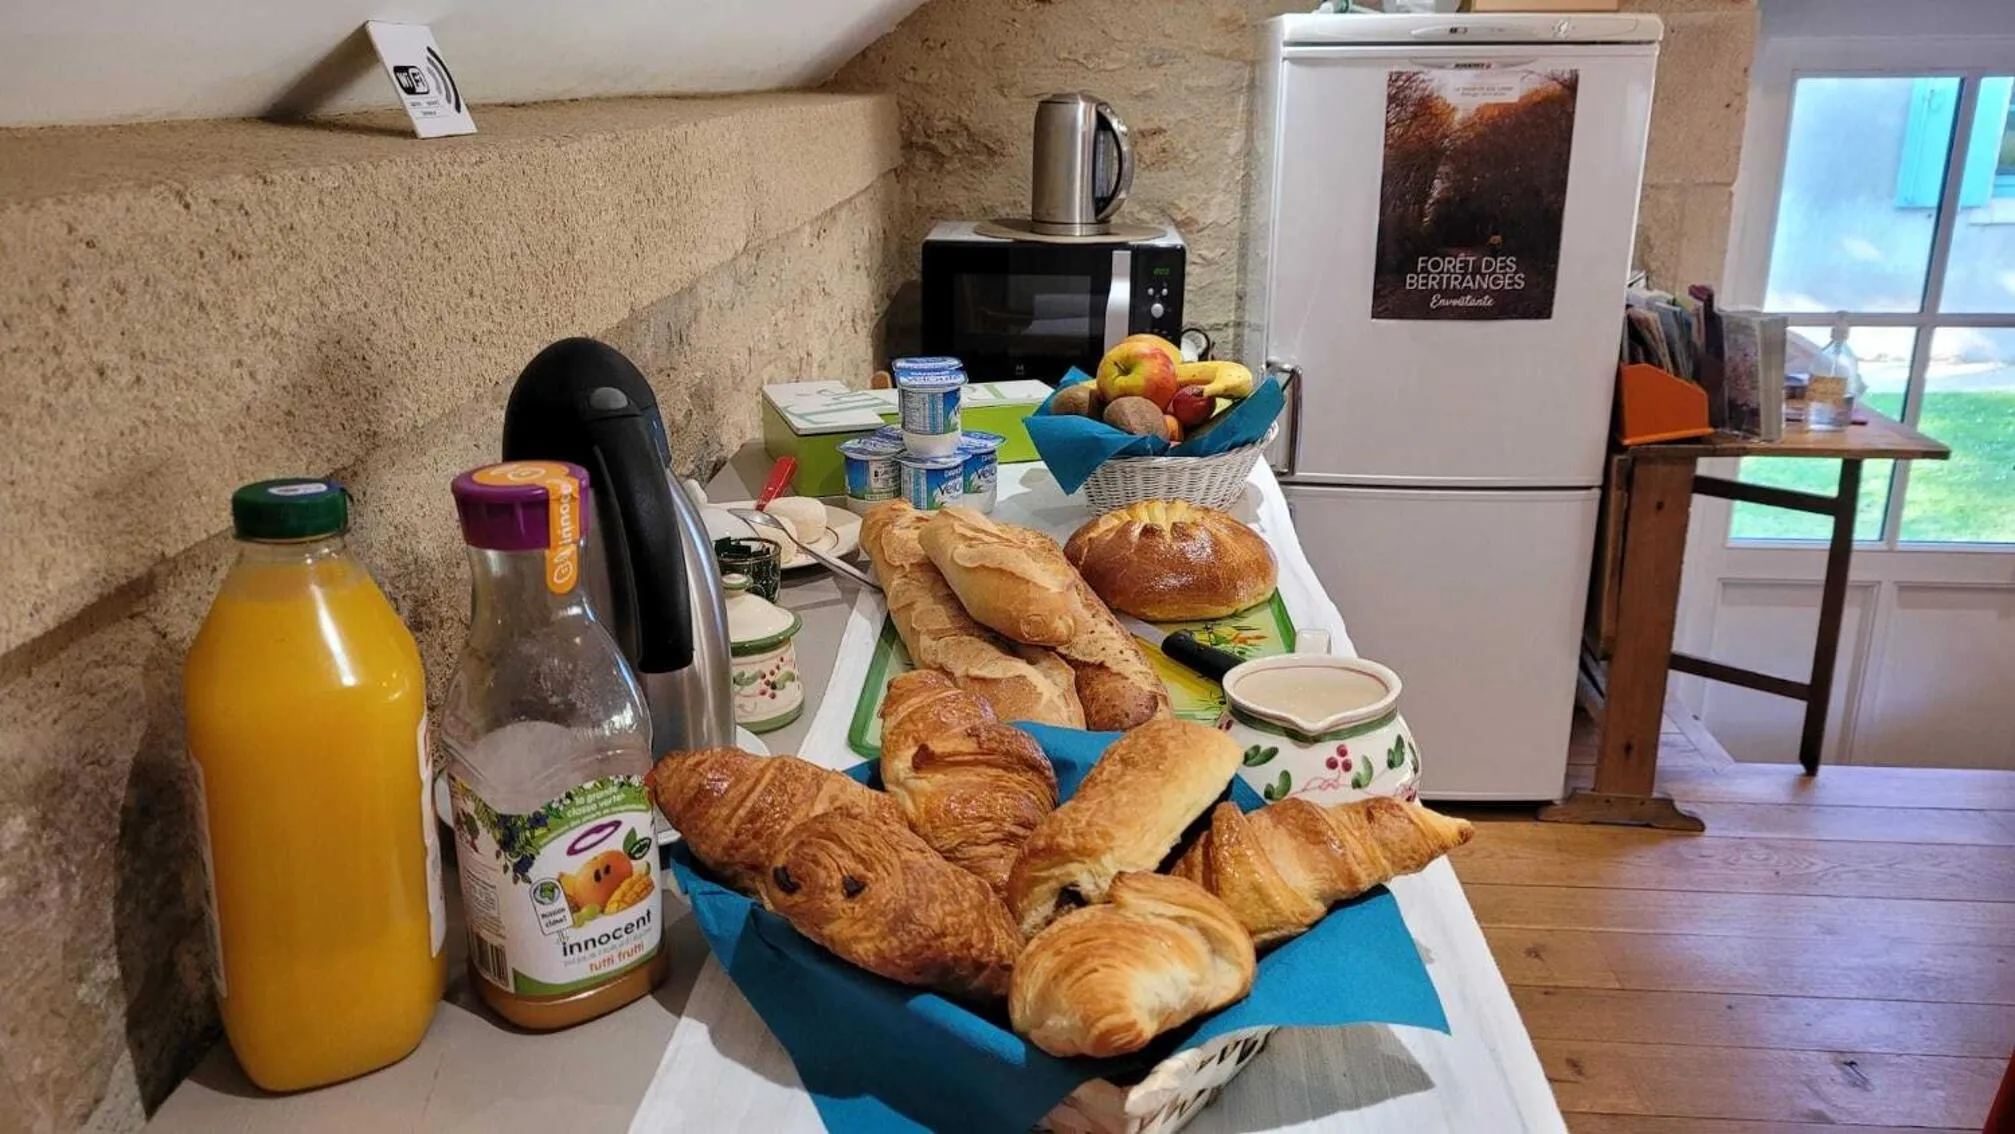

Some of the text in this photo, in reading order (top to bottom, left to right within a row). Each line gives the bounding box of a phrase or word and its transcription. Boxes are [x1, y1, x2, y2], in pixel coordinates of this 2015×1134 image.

[1416, 252, 1517, 274] FORÊT DES
[1405, 273, 1526, 290] BERTRANGES
[562, 908, 652, 957] innocent
